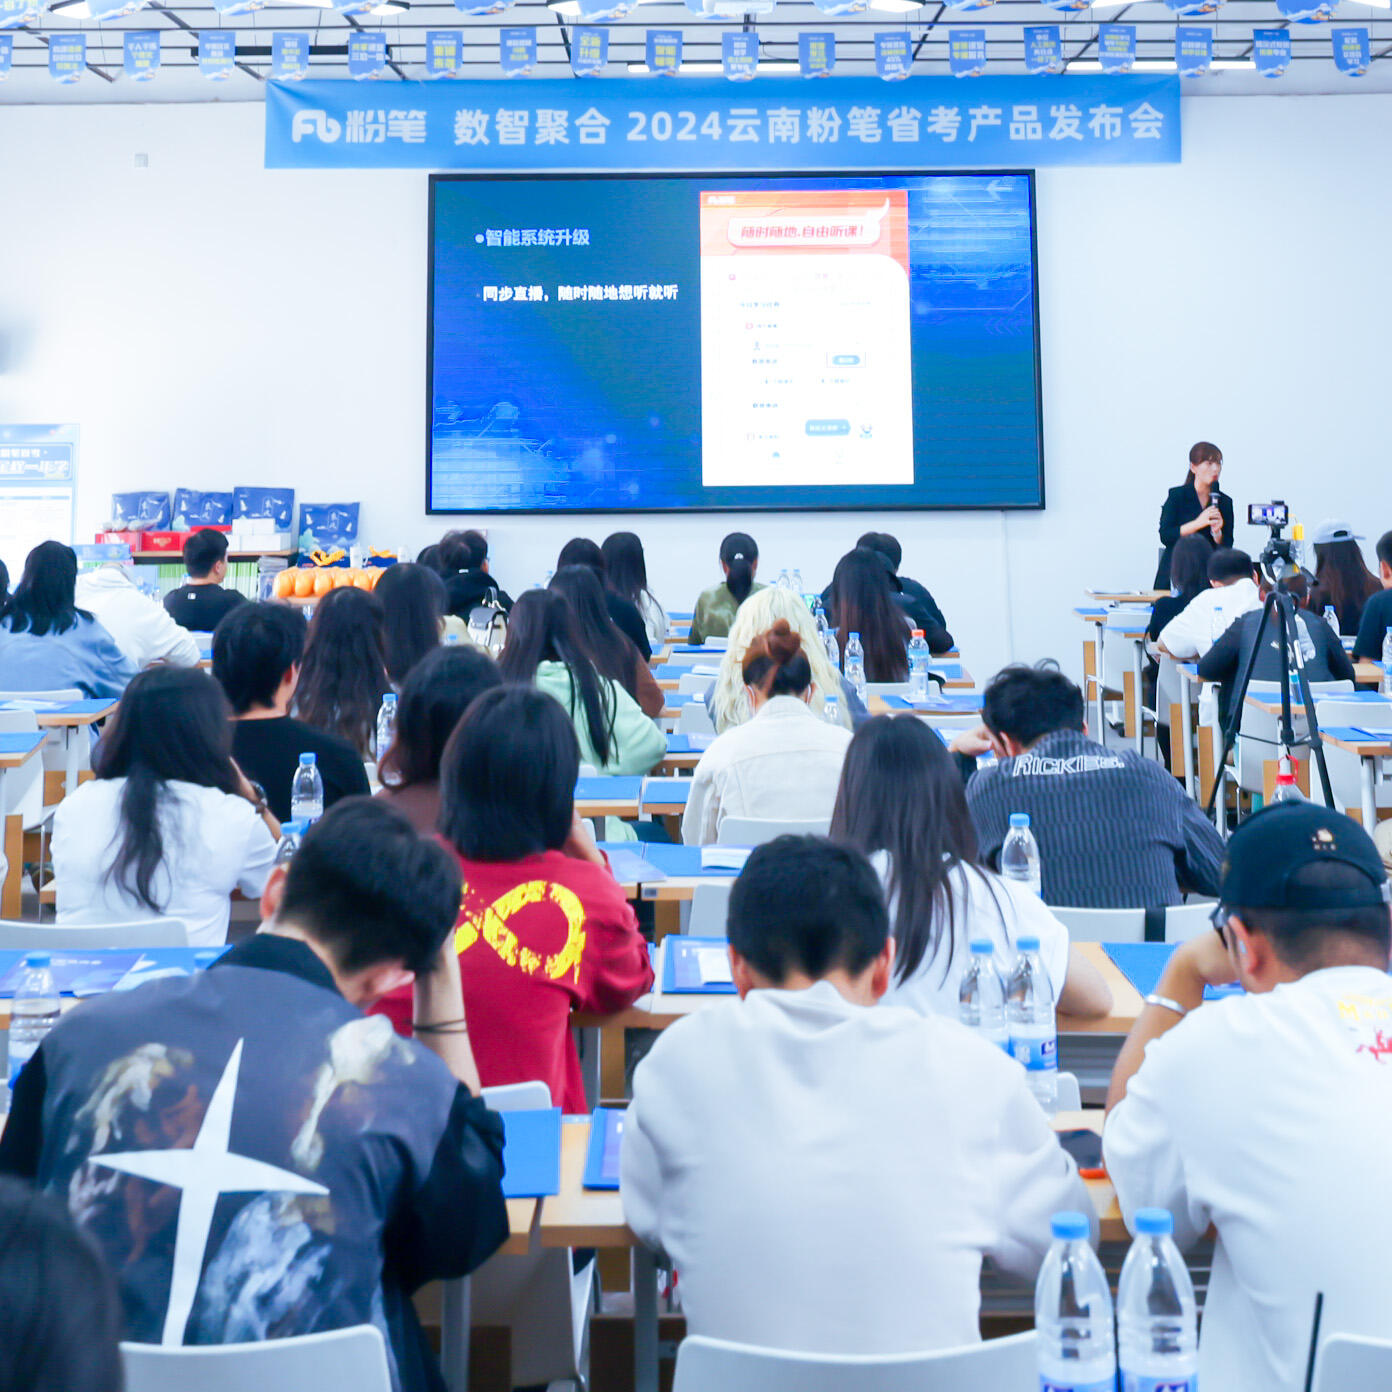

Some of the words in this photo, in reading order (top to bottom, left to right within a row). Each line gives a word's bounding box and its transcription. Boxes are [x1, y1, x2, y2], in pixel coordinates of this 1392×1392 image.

[454, 107, 611, 145] 数智聚合
[626, 102, 1165, 145] 2024云南粉笔省考产品发布会
[484, 228, 590, 247] 智能系统升级
